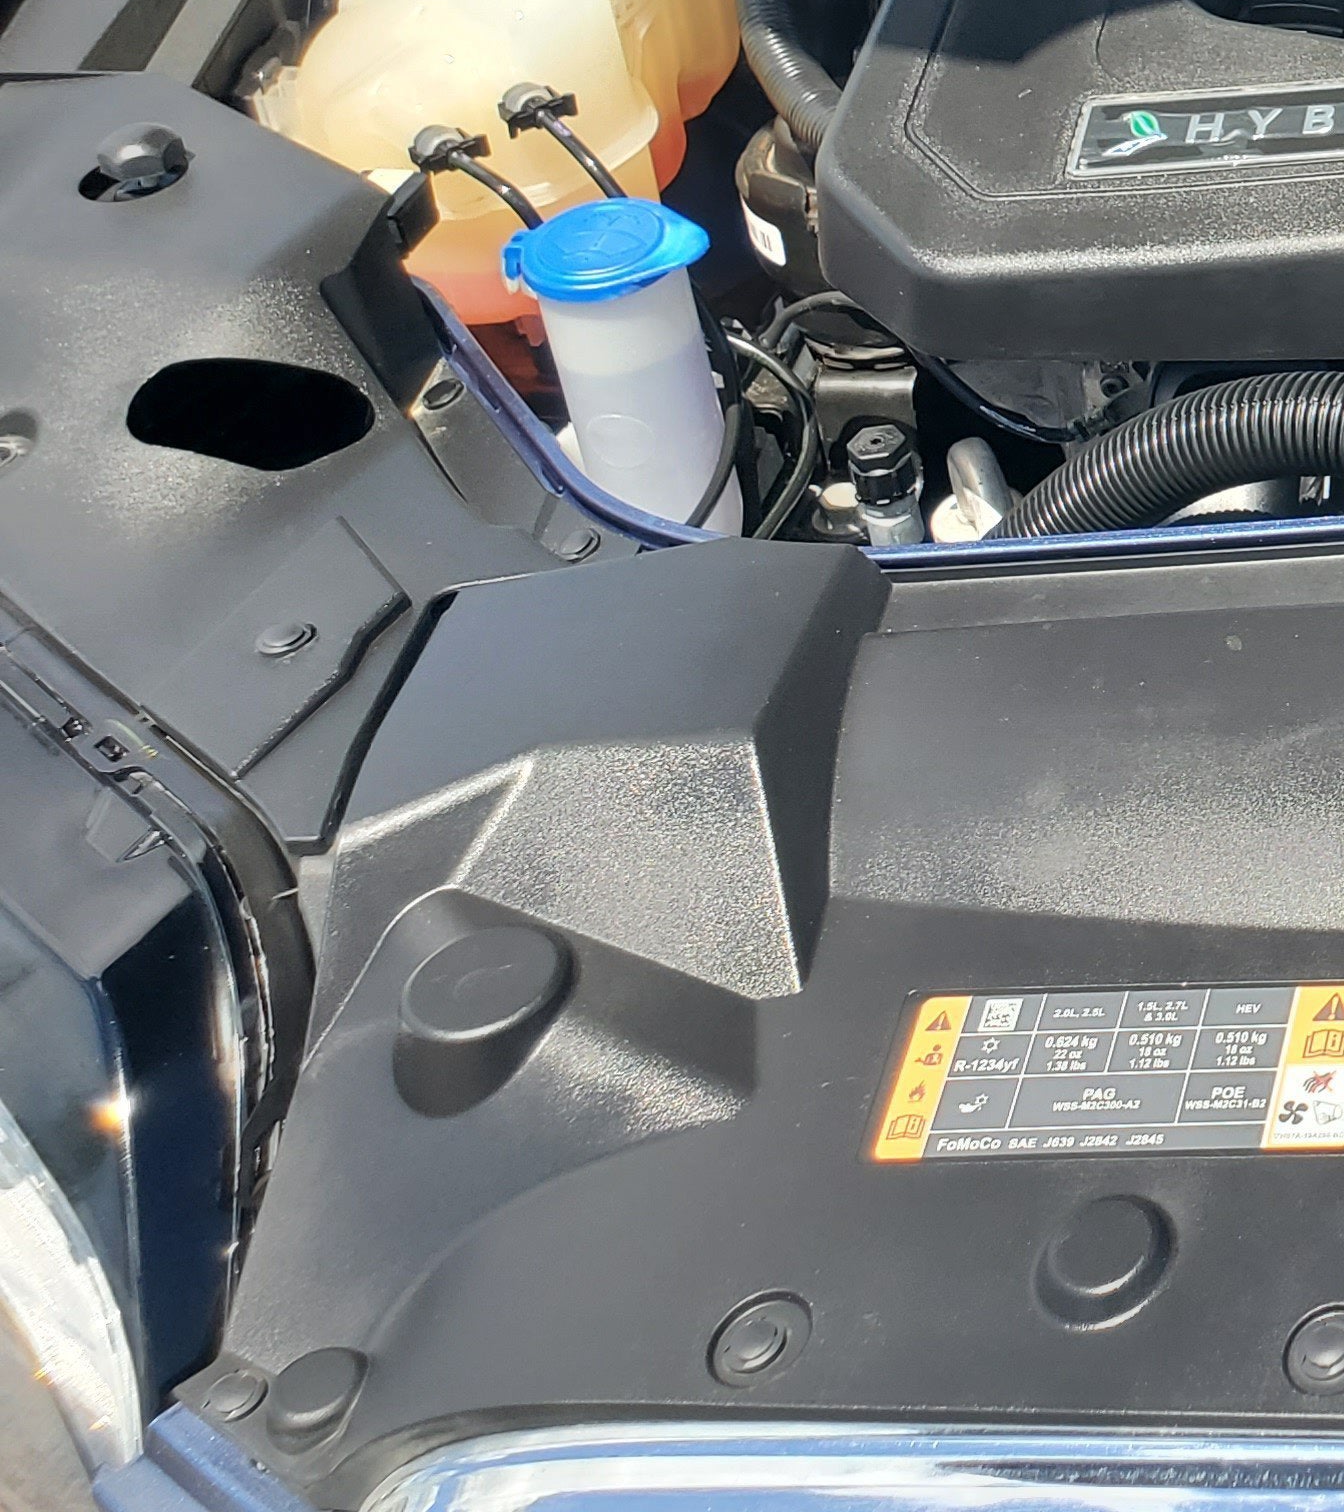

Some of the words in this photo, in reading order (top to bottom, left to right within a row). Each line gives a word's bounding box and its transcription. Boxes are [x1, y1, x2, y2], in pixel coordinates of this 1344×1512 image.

[1236, 1003, 1261, 1014] HEV
[1044, 1036, 1079, 1048] 0.624
[1080, 1036, 1098, 1050] kg
[1128, 1033, 1163, 1045] 0.510
[1164, 1033, 1182, 1046] kg
[1215, 1031, 1249, 1043] 0.510
[1250, 1031, 1267, 1045] kg
[1053, 1049, 1066, 1059] 22
[1068, 1050, 1082, 1059] oz
[1152, 1047, 1167, 1056] oz
[1238, 1046, 1253, 1054] oz
[953, 1058, 1019, 1073] R-1234yf
[1070, 1061, 1086, 1071] lbs
[1129, 1058, 1151, 1069] 1.12
[1153, 1058, 1169, 1068] lbs
[1216, 1056, 1237, 1066] 1.12
[1239, 1056, 1256, 1066] lbs
[1082, 1087, 1116, 1101] PAG
[1211, 1086, 1246, 1099] POE
[936, 1137, 1001, 1151] FoMoCo
[1008, 1137, 1037, 1149] SAE
[1043, 1136, 1075, 1148] J639
[1080, 1135, 1118, 1147] J2842
